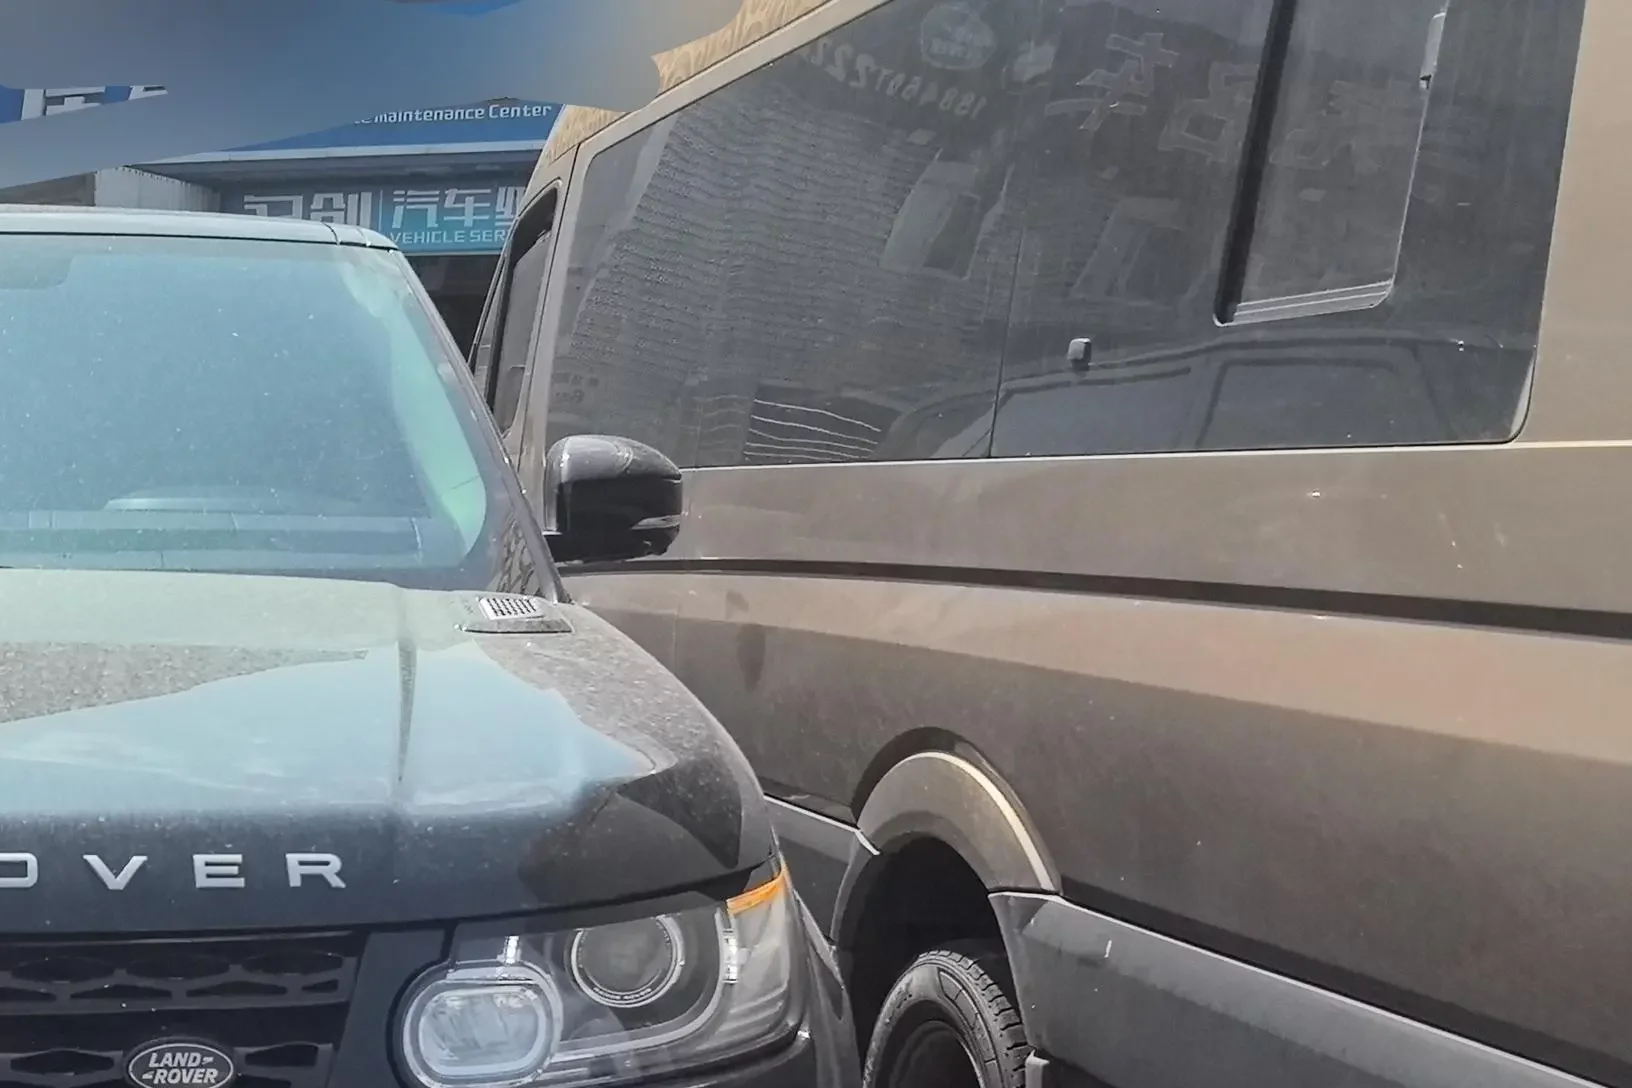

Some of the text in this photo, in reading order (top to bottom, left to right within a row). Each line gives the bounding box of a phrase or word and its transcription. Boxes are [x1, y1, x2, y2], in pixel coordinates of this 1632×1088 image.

[489, 103, 553, 119] Center
[390, 230, 466, 244] VEHICLE
[148, 1052, 202, 1068] LAND
[152, 1068, 219, 1085] ROVER
